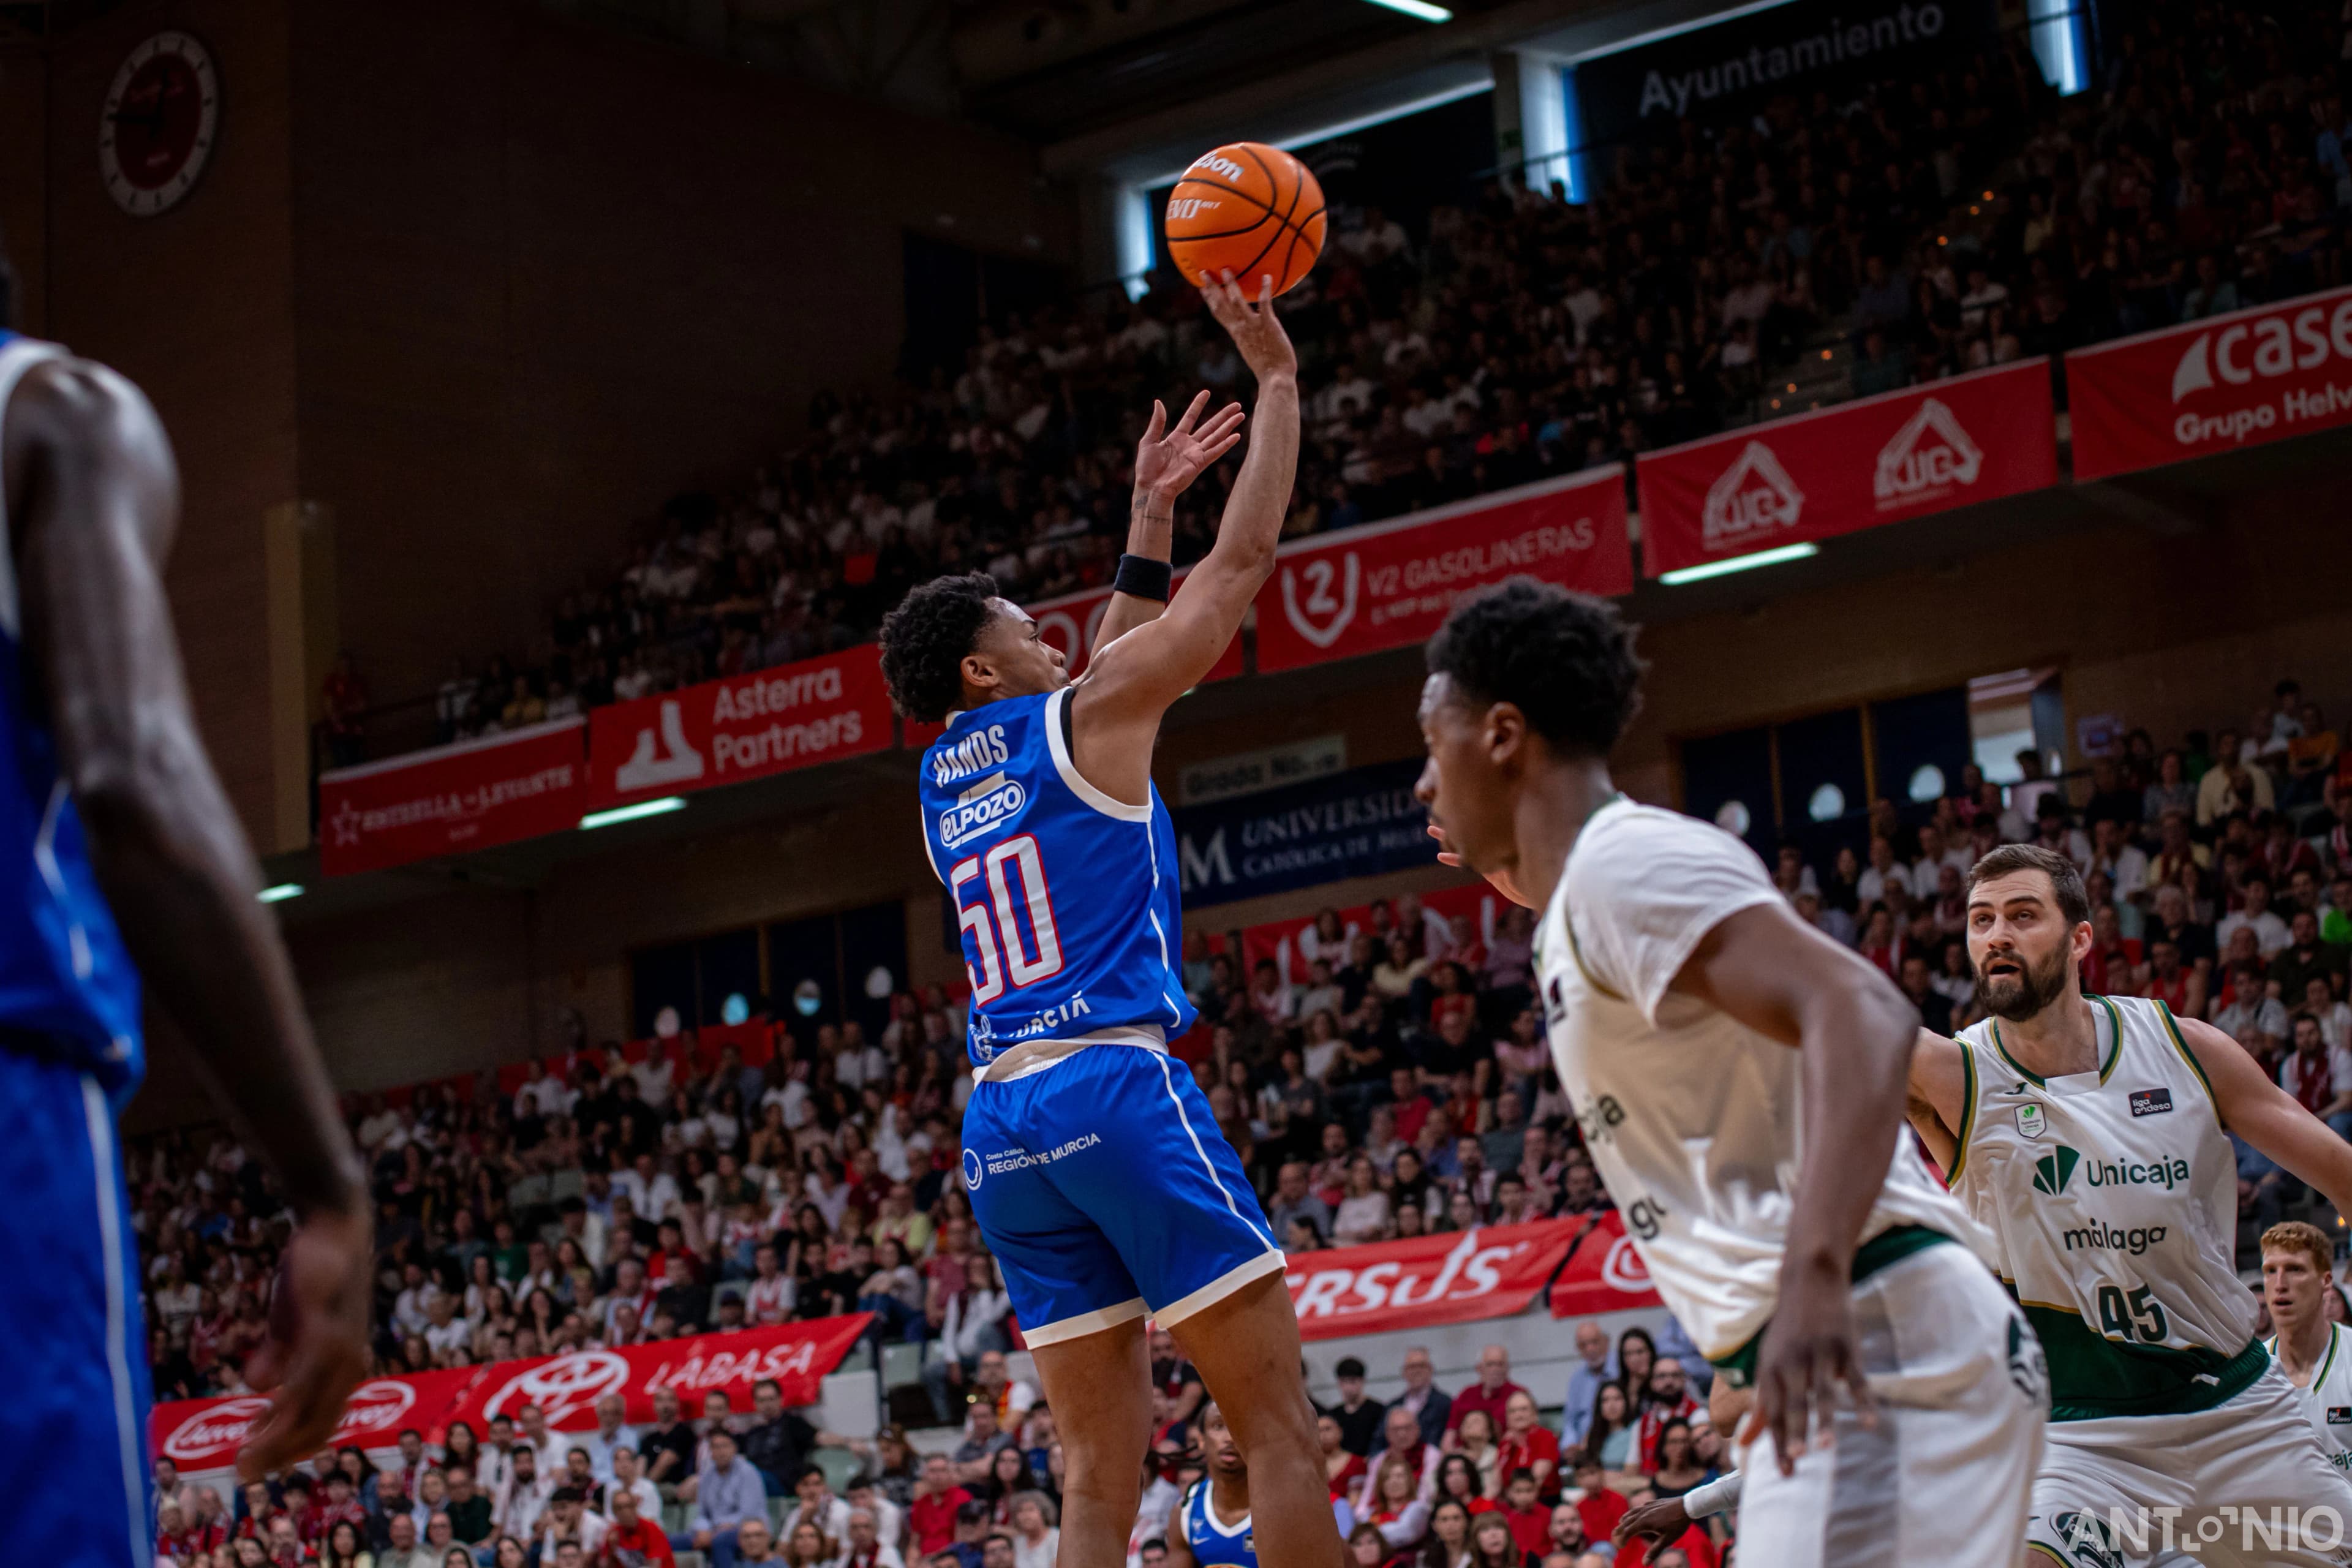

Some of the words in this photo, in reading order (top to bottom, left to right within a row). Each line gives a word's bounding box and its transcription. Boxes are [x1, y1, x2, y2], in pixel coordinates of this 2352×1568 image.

[1639, 3, 1943, 118] Ayuntamiento
[2174, 403, 2277, 445] Grupo
[1403, 517, 1596, 590] GASOLINERAS
[713, 667, 843, 725] Asterra
[713, 710, 863, 773] Partners
[933, 725, 1009, 788] HANDS
[950, 832, 1065, 1009] 50
[2132, 1099, 2150, 1107] liga
[2135, 1102, 2171, 1114] endesa
[986, 1152, 1003, 1161] Costa
[987, 1154, 1038, 1175] REGIÓN
[1036, 1152, 1051, 1164] DE
[1051, 1132, 1101, 1161] MURCIA
[2086, 1155, 2190, 1190] Unicaja
[2098, 1283, 2168, 1342] 45
